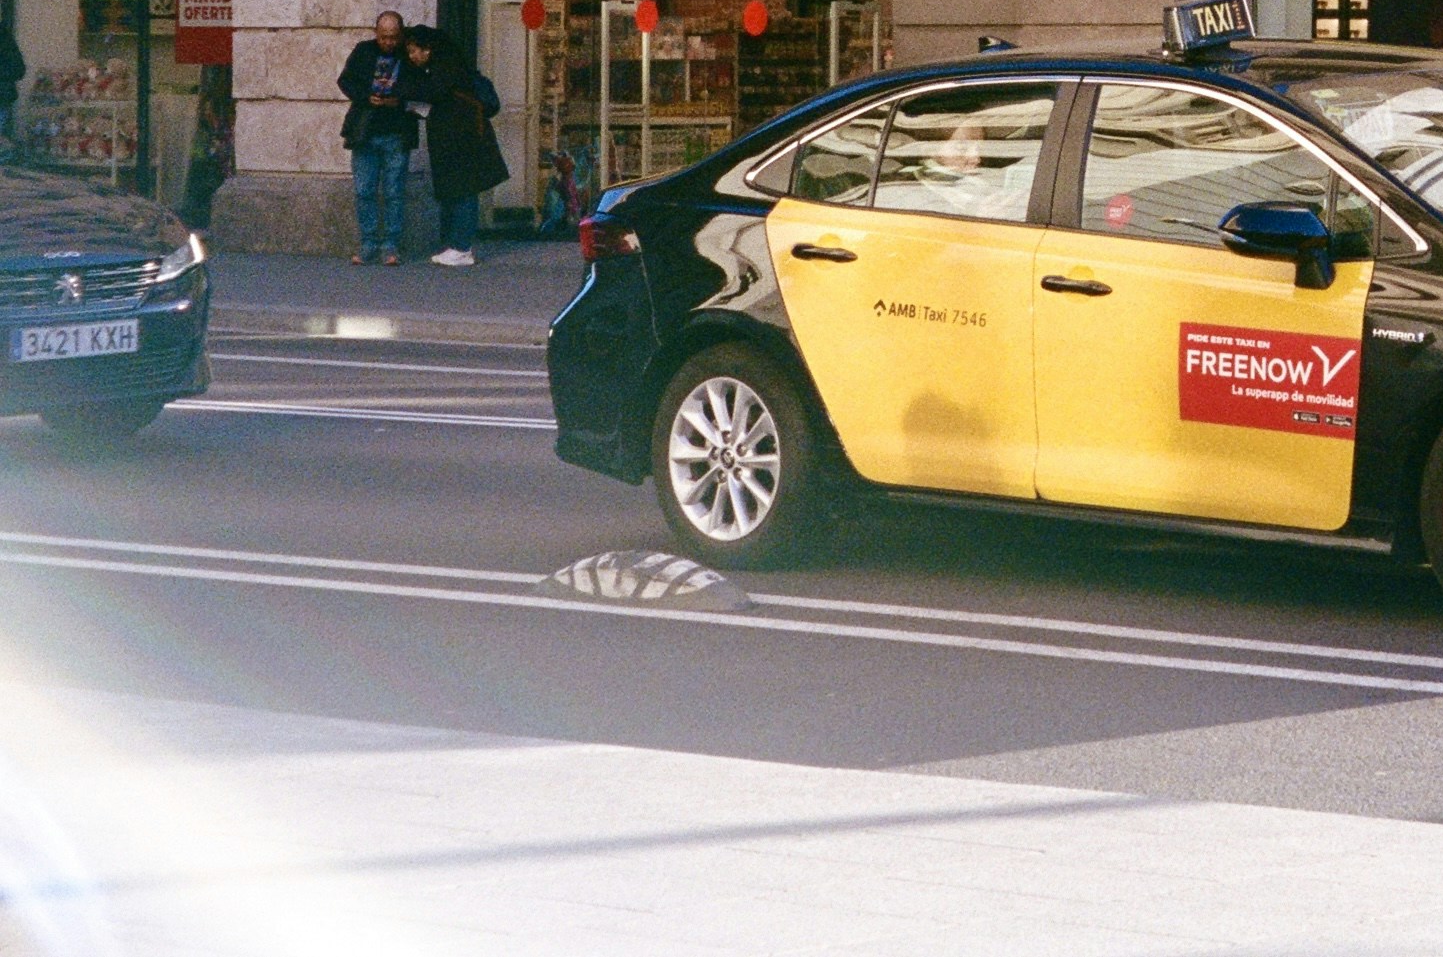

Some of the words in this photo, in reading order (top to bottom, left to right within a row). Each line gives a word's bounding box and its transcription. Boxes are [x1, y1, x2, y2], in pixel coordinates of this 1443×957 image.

[1192, 2, 1235, 36] TAXI
[888, 302, 916, 318] AMB
[923, 305, 947, 323] Taxi
[952, 310, 987, 328] 7546
[27, 329, 80, 356] 3421
[90, 325, 133, 351] KXH
[1187, 333, 1209, 344] PIDE
[1210, 335, 1234, 346] ESTE
[1235, 338, 1256, 348] TAXI
[1257, 340, 1270, 349] EN
[1186, 349, 1313, 386] FREENOW
[1231, 385, 1244, 396] La
[1245, 388, 1288, 402] superapp
[1291, 390, 1304, 402] de
[1306, 393, 1354, 408] movilidad
